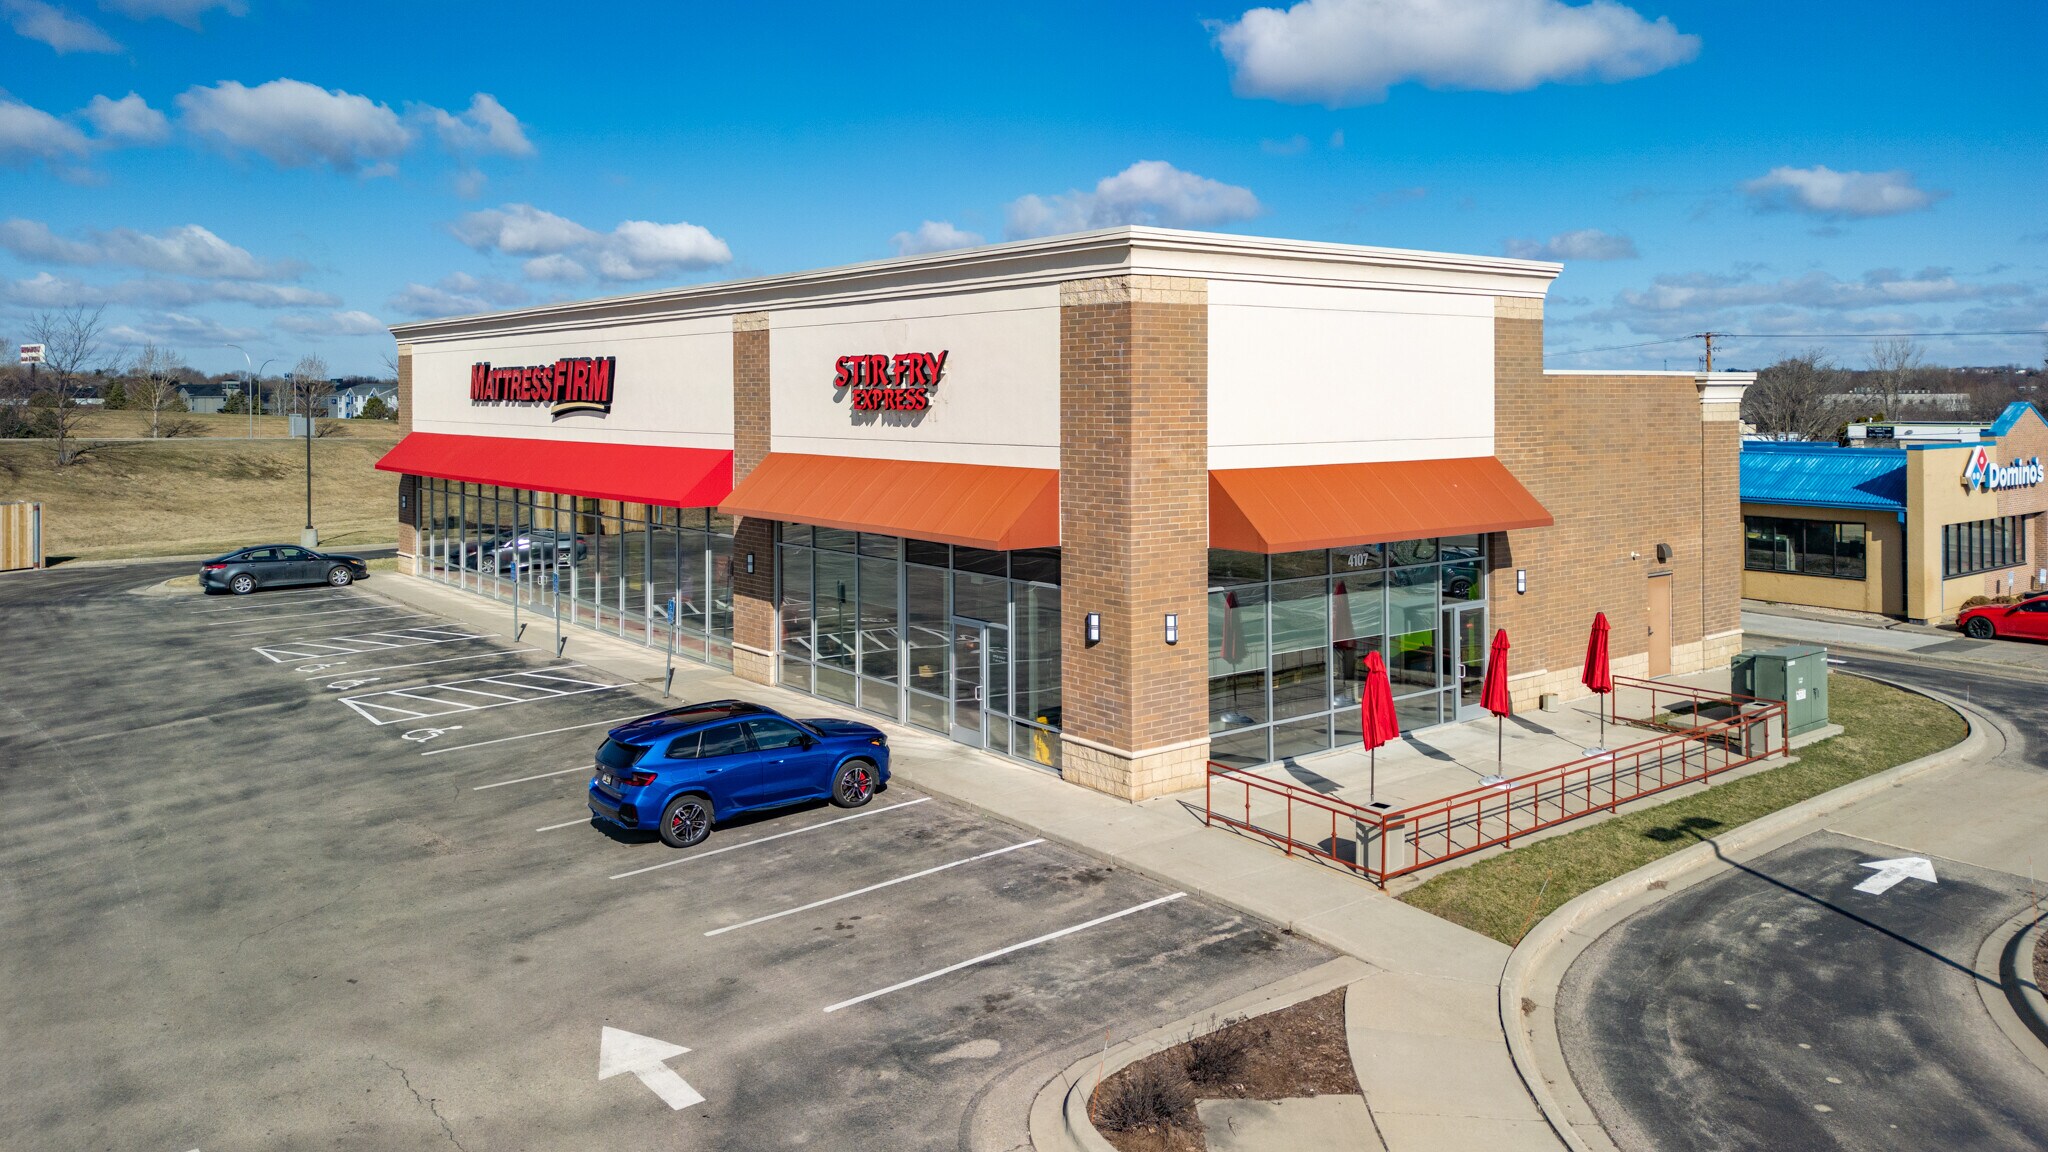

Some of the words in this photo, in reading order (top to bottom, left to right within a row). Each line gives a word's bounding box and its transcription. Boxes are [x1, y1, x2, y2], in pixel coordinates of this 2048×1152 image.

[835, 353, 889, 387] STIR
[892, 350, 948, 386] FRY
[852, 388, 928, 411] EXPRESS
[1988, 457, 2045, 488] Domino's
[1347, 552, 1369, 567] 4107
